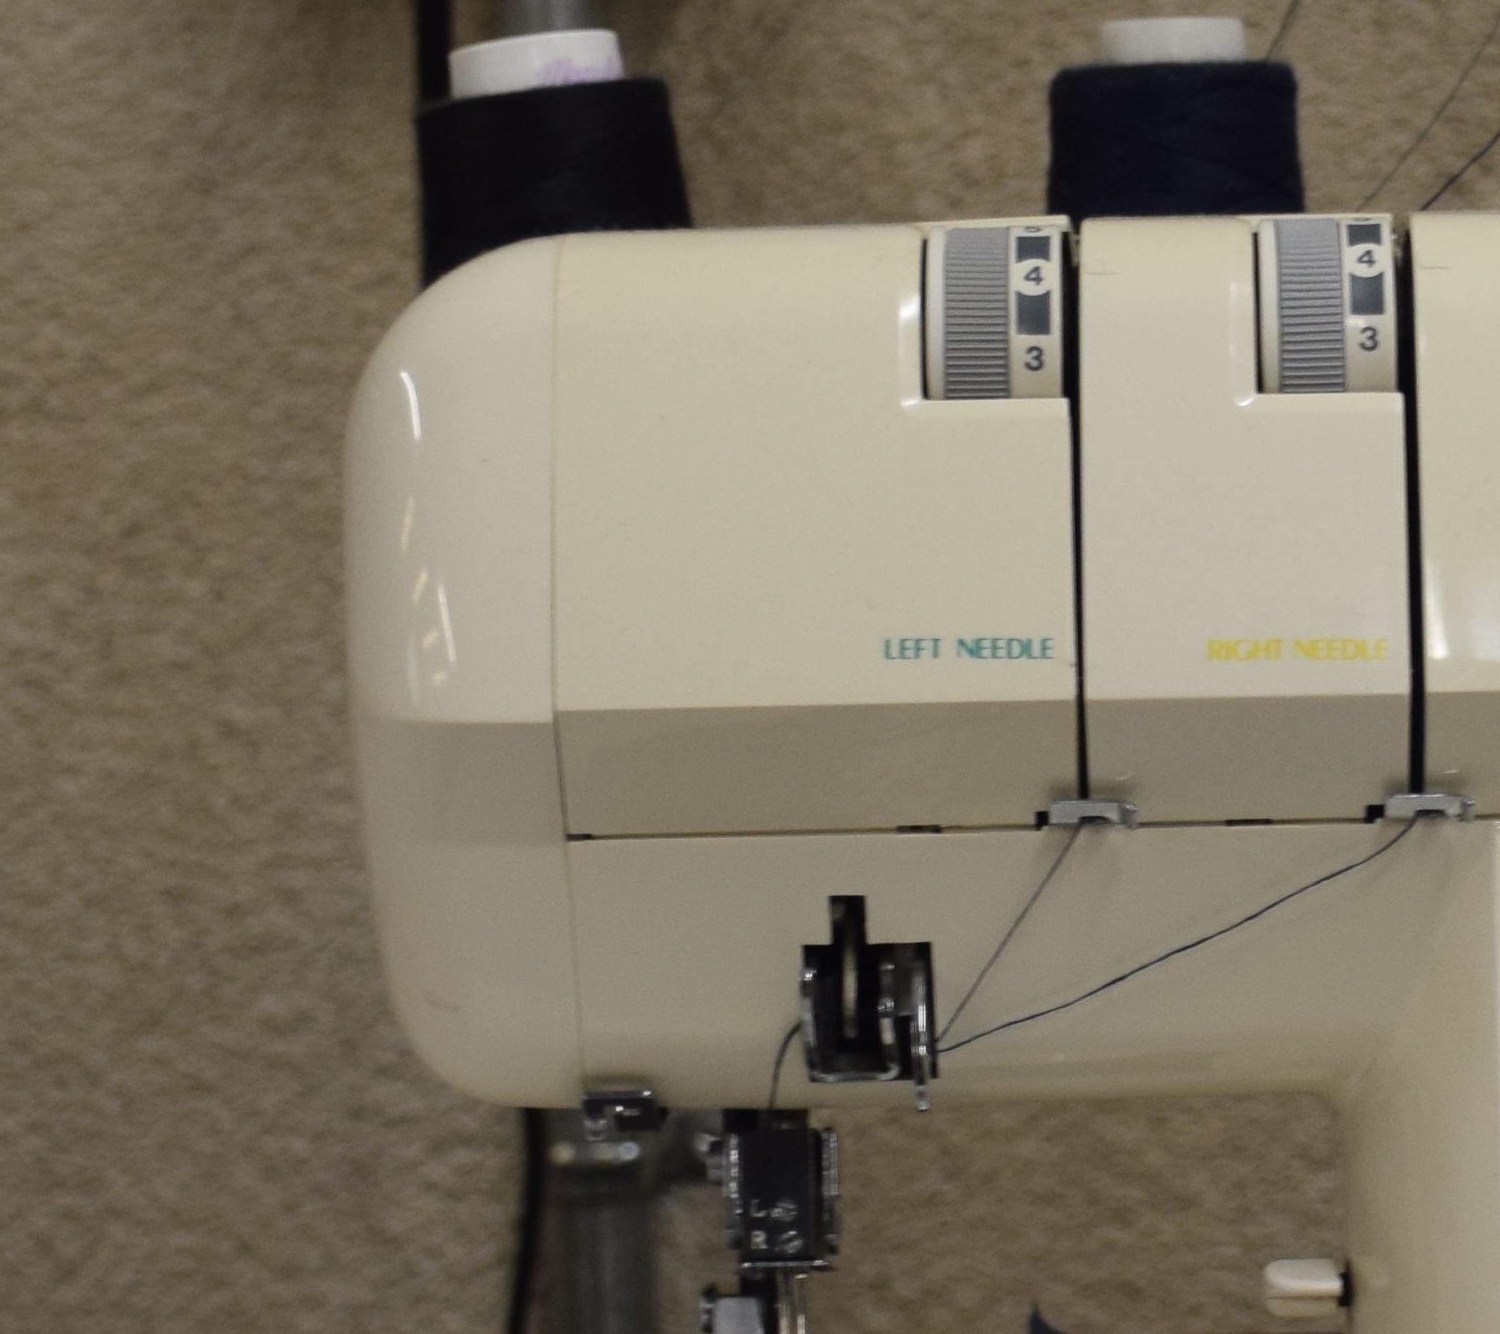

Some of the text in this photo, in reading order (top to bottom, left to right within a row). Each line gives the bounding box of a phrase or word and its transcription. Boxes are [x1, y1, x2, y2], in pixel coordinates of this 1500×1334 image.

[1357, 250, 1378, 268] 4
[1023, 267, 1044, 285] 4
[1358, 328, 1378, 351] 3
[1025, 347, 1044, 371] 3
[884, 638, 1054, 660] LEFT NEEDLE
[1207, 638, 1389, 662] RIGHT NEEDLE
[751, 1230, 768, 1249] R
